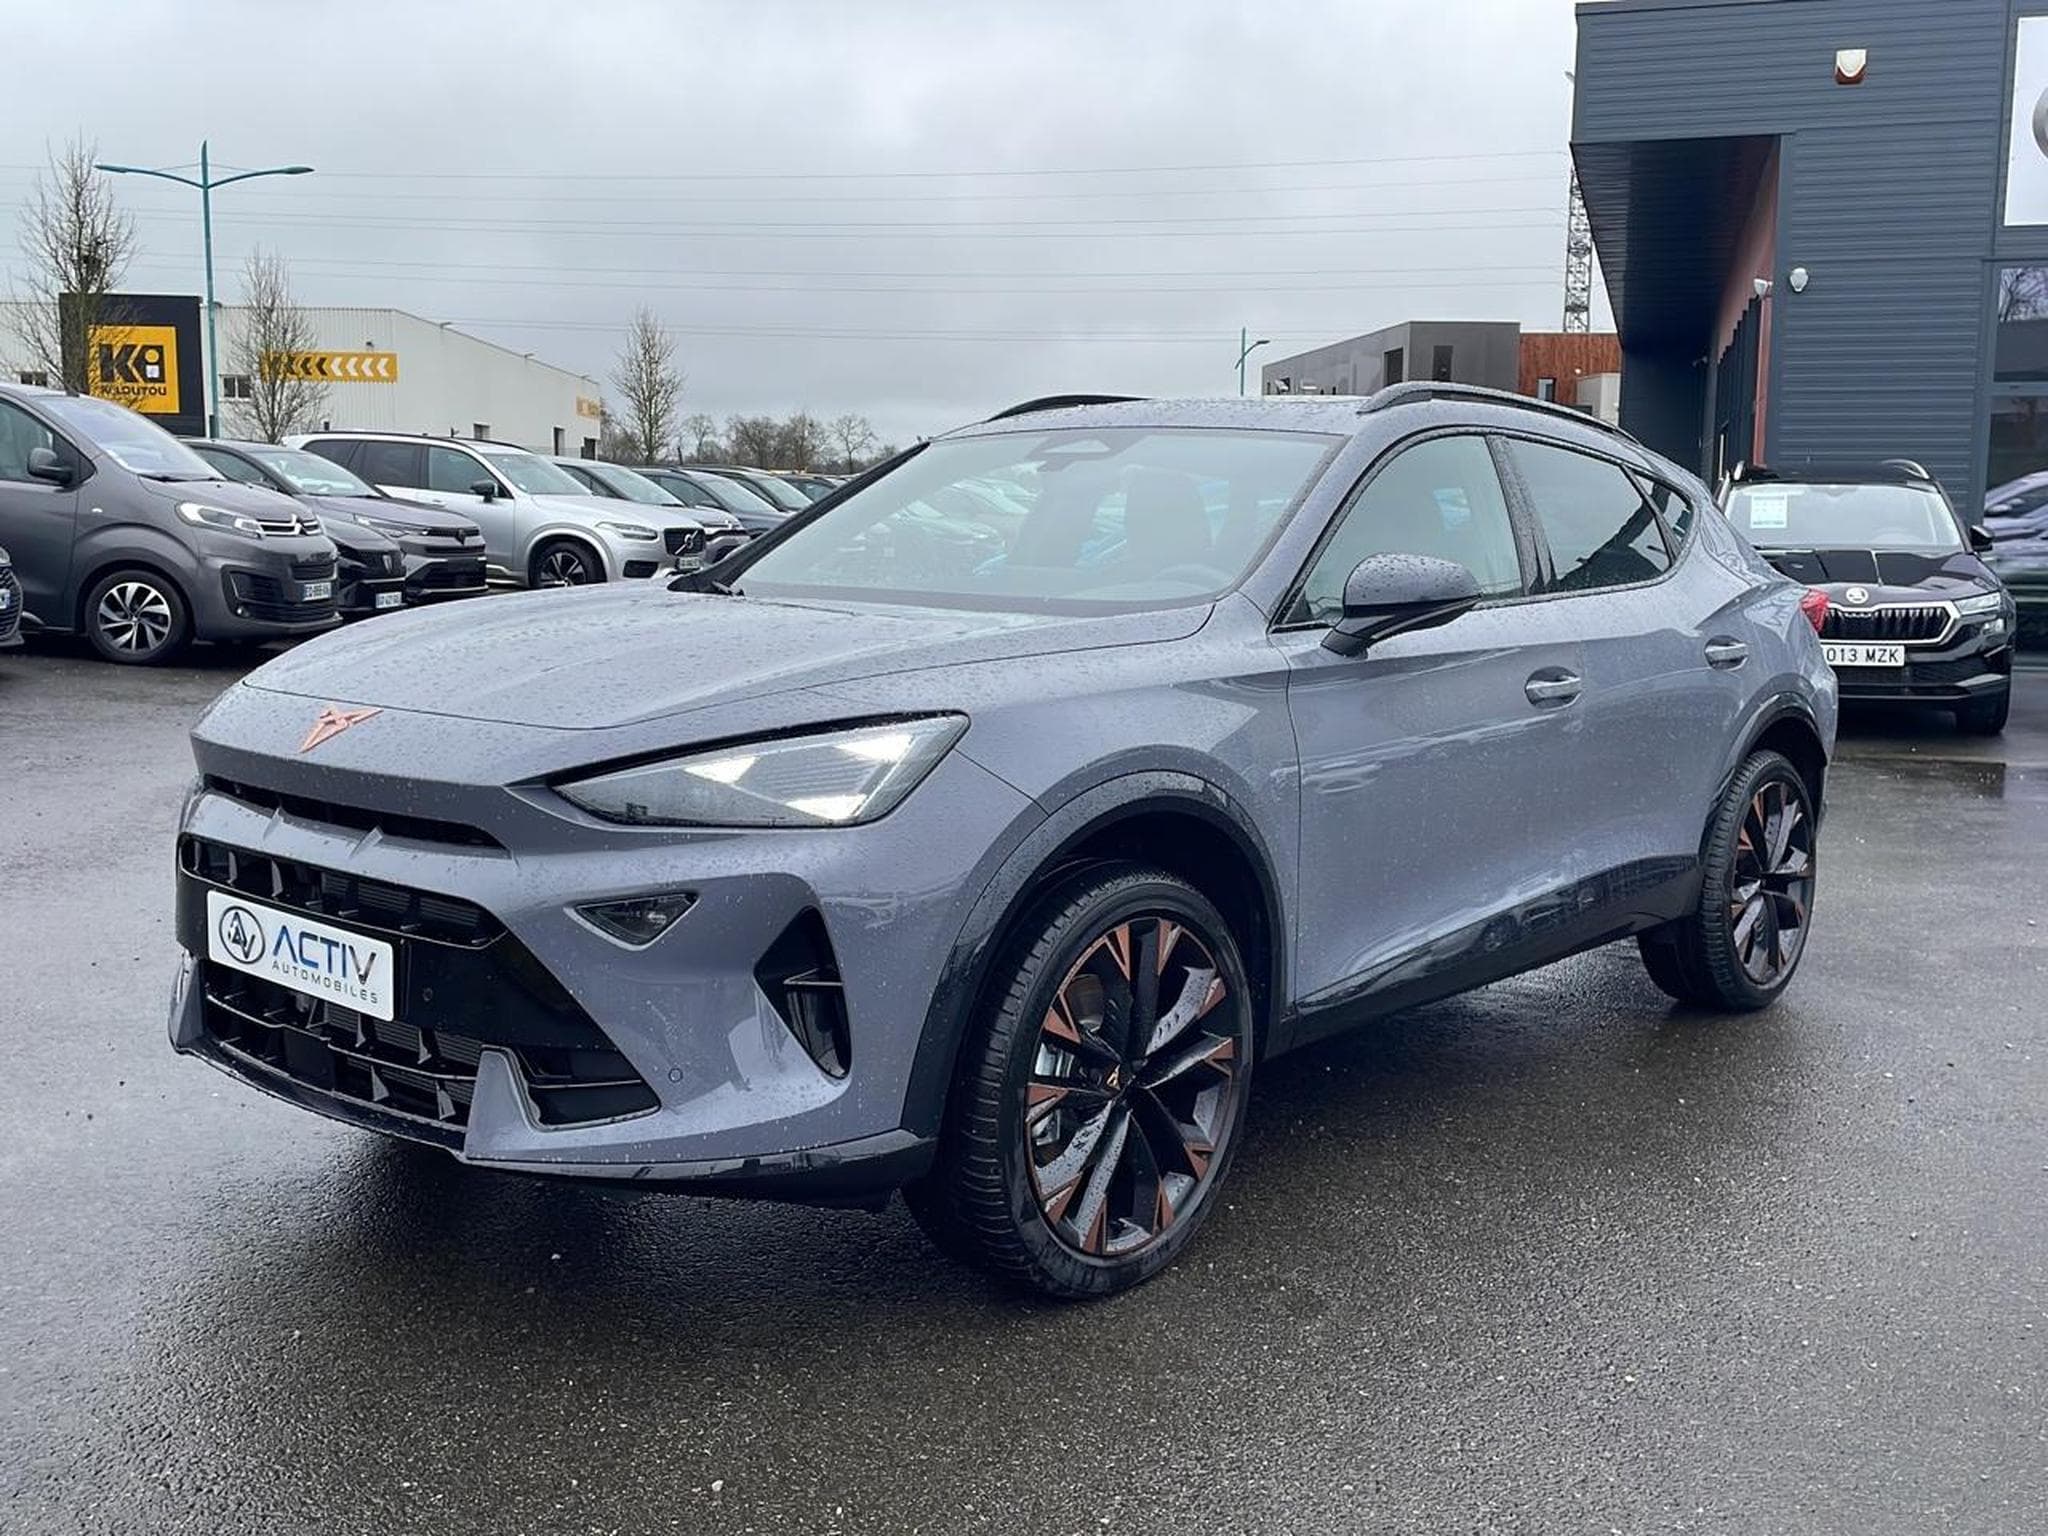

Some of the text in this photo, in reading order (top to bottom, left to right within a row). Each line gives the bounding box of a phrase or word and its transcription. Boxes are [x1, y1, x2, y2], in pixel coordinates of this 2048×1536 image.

[1865, 648, 1899, 663] MZK
[273, 925, 377, 985] ACTIV
[271, 960, 379, 1004] AUTOMOBILES
